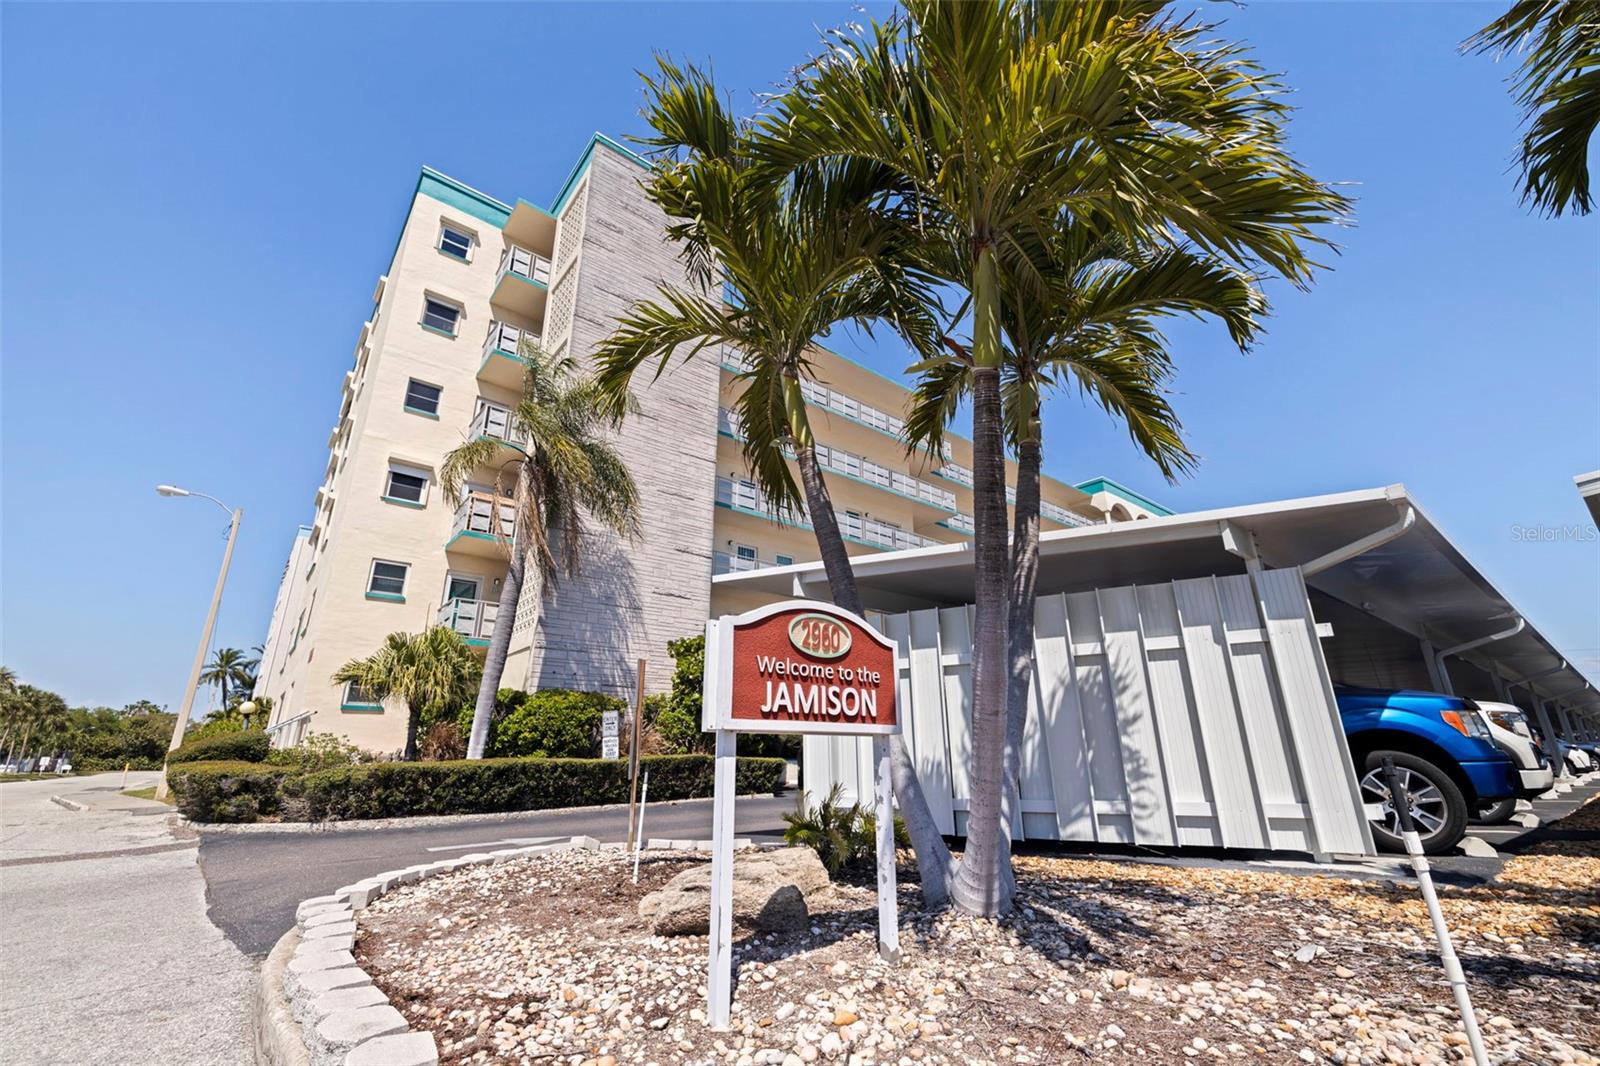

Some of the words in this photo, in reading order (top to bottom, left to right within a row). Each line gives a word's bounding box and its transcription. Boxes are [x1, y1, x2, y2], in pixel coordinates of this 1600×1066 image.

[801, 620, 841, 653] 2960
[757, 655, 834, 679] Welcome
[838, 665, 854, 681] to
[857, 667, 881, 684] the
[761, 681, 877, 717] JAMISON
